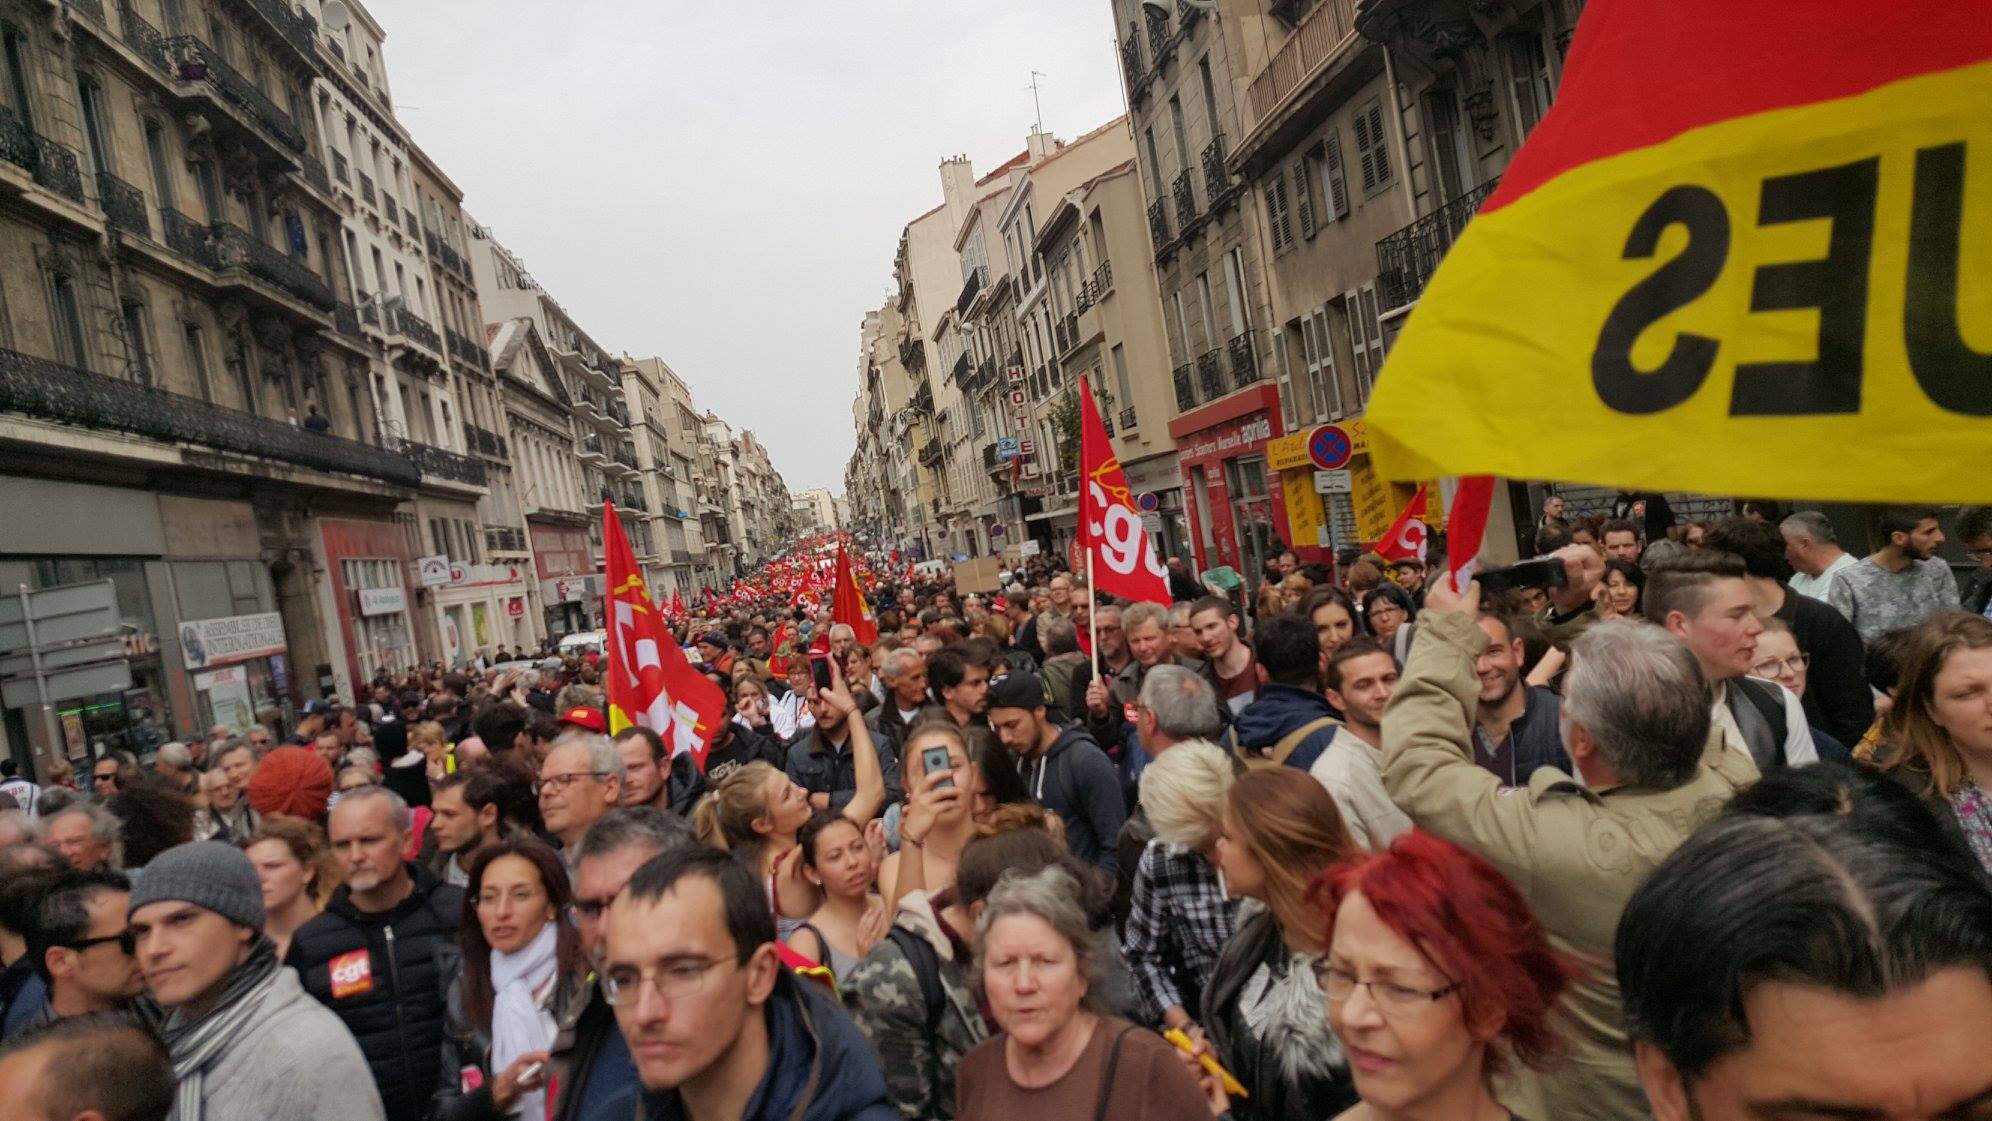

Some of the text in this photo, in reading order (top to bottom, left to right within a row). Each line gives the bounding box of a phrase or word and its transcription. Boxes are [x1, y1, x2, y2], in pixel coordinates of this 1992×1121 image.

[1007, 366, 1038, 478] HOTEL
[1242, 421, 1271, 449] aprilia
[331, 957, 371, 983] cgt
